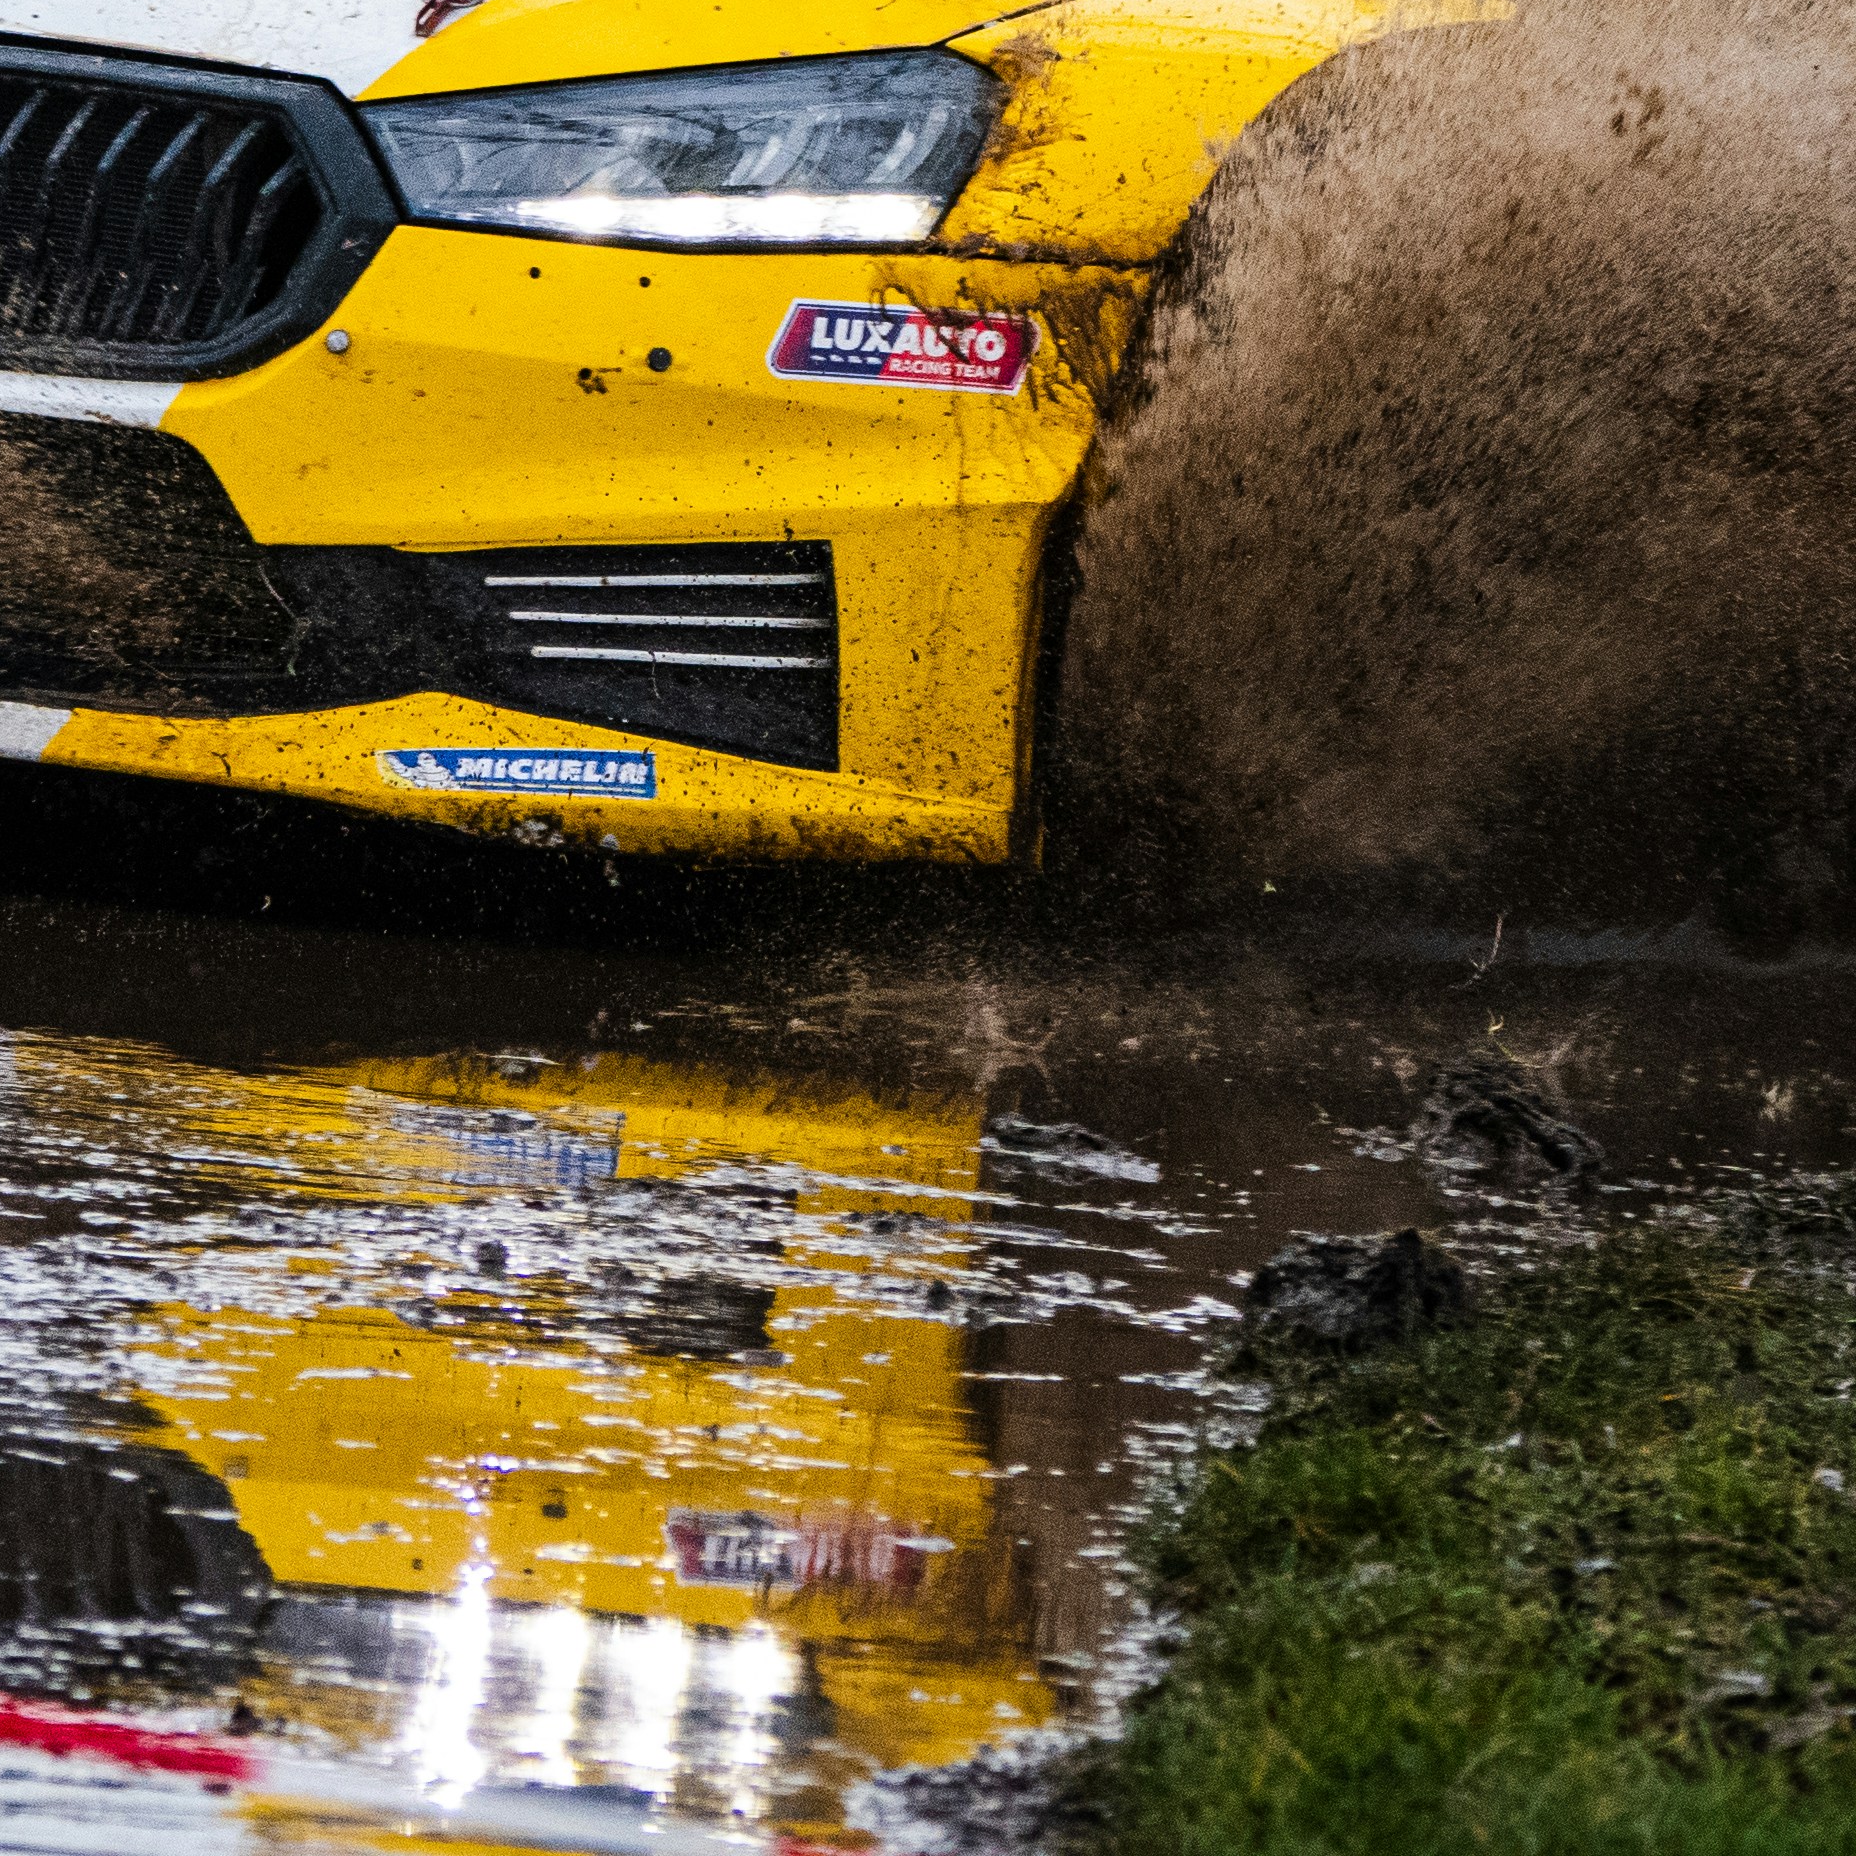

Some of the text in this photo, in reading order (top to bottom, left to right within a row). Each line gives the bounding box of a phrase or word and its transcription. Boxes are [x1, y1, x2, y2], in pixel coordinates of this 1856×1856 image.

[810, 316, 1007, 362] LUXAUTO
[889, 358, 1001, 380] RACING TEAM
[455, 757, 648, 784] MICHELIN
